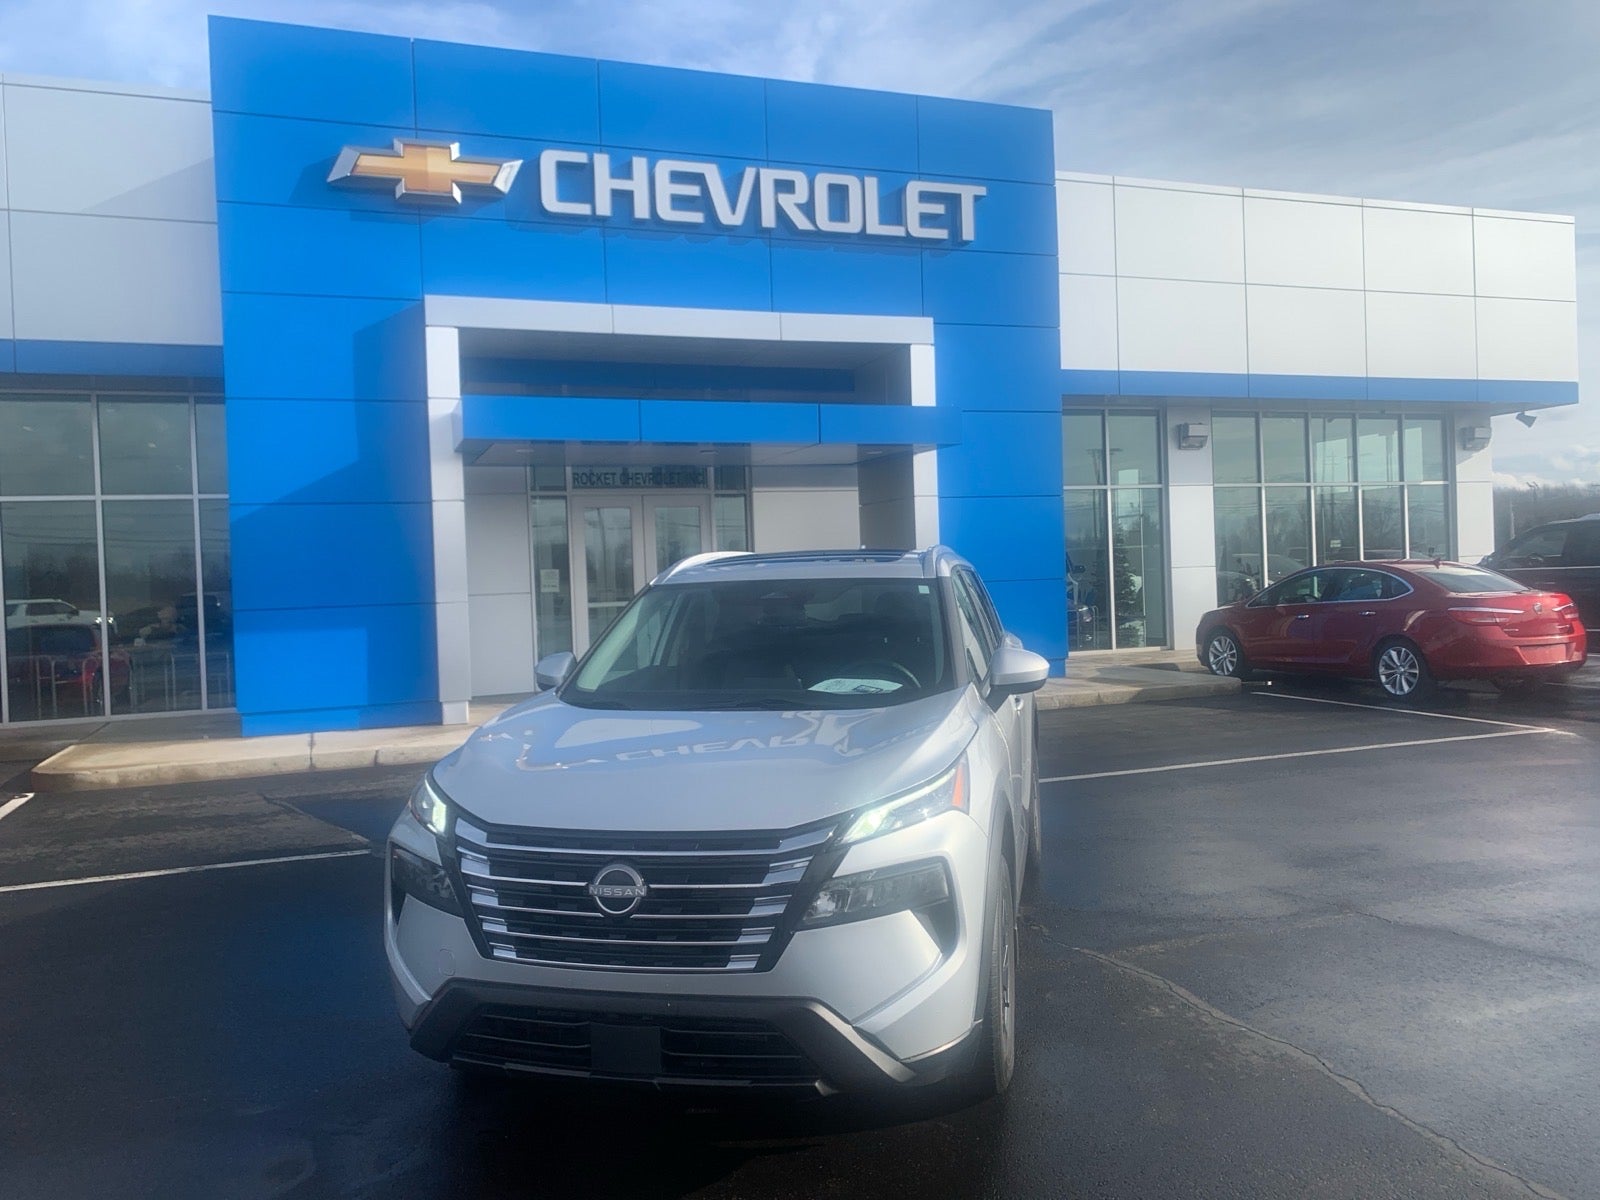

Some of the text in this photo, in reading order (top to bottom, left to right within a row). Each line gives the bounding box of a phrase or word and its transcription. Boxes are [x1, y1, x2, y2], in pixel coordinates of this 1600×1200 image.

[539, 149, 986, 242] CHEVROLET
[572, 472, 617, 486] ROCKET
[589, 886, 645, 897] NISSAN
